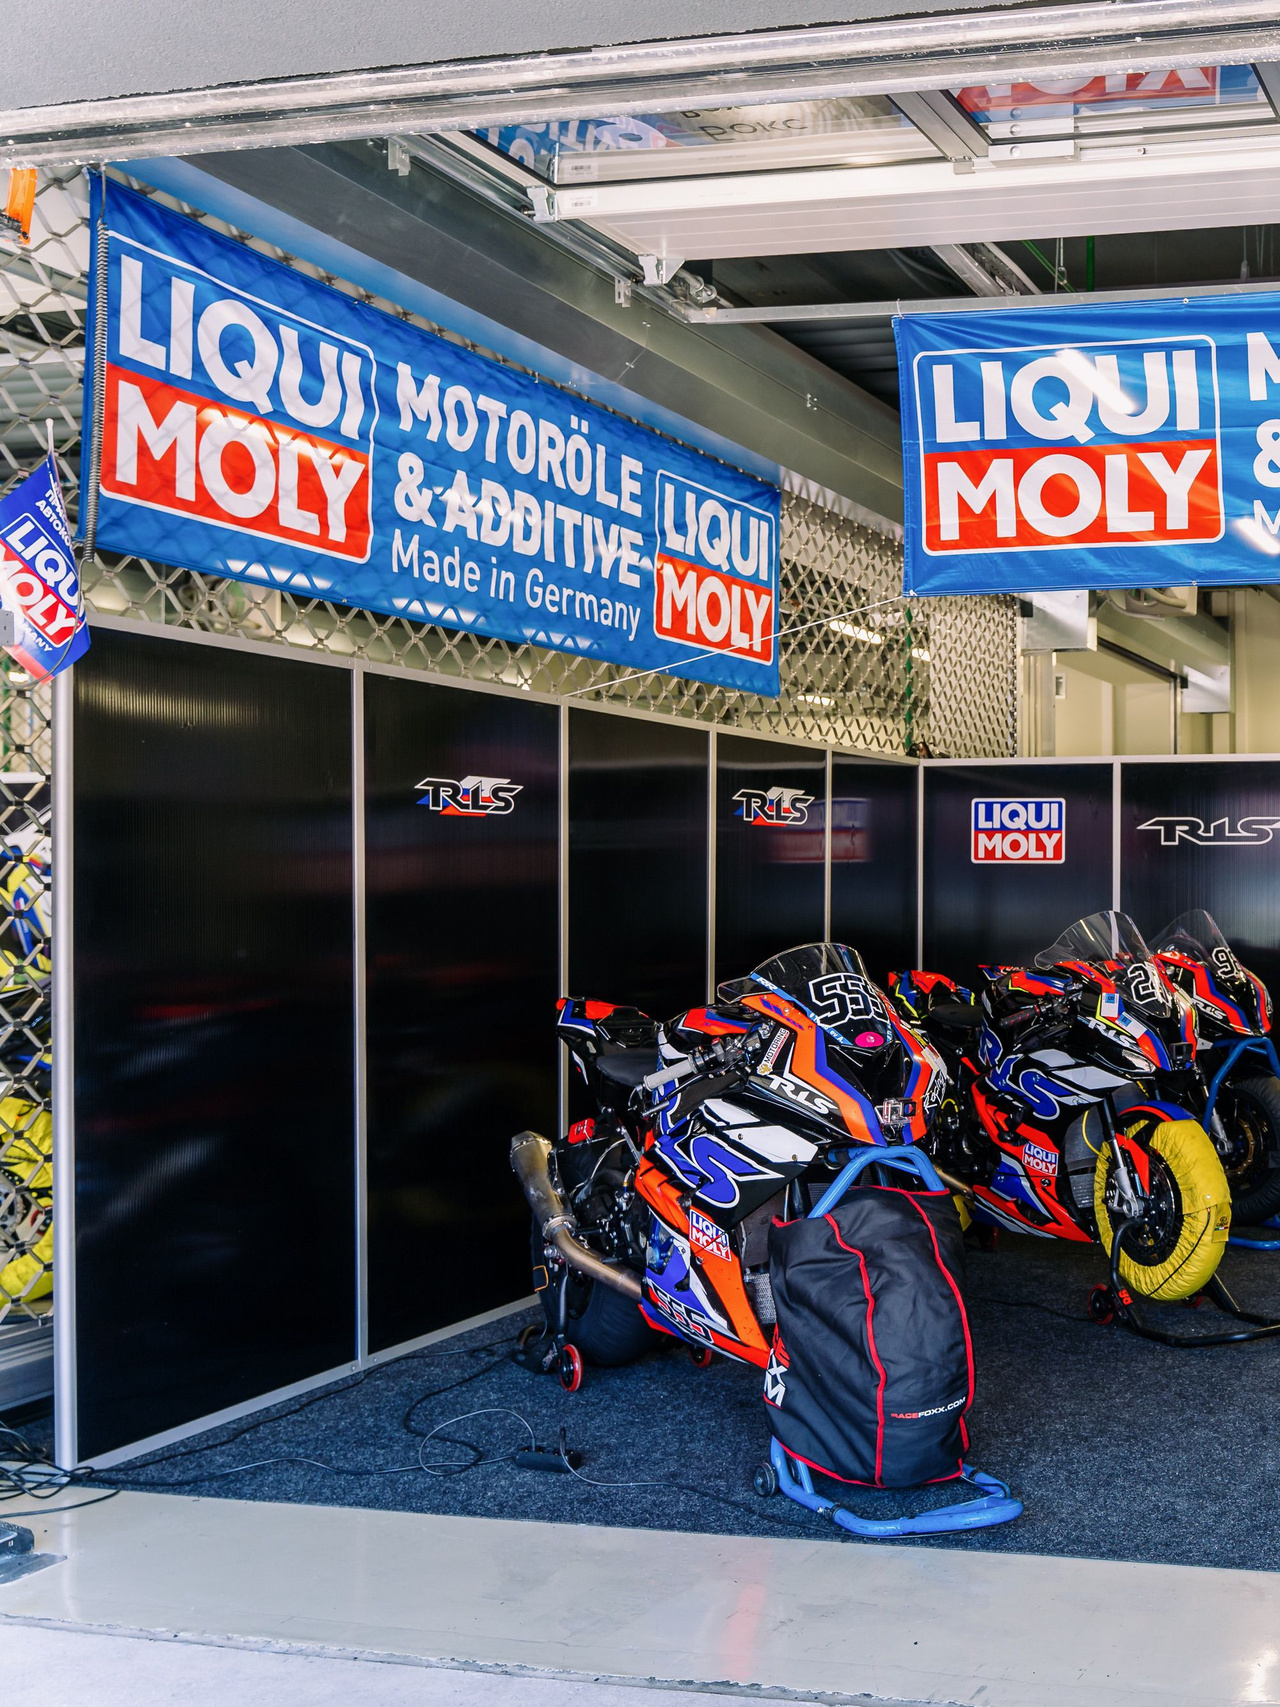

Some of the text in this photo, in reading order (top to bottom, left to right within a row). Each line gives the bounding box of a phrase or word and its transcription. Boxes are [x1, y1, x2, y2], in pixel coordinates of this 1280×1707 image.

[119, 251, 365, 441] LIQUI
[398, 361, 644, 518] MOTORÖLE
[932, 349, 1201, 444] LIQUI
[116, 380, 366, 543] MOLY
[938, 449, 1213, 543] MOLY
[396, 452, 644, 588] & ADDITIVE
[662, 481, 770, 580] LIQUI
[392, 530, 642, 641] Made in Germany
[659, 569, 771, 662] MOLY
[977, 832, 1061, 860] MOLY
[978, 803, 1060, 831] LIQUI
[764, 1028, 787, 1064] MOTORING
[1024, 1153, 1057, 1175] MOLY
[1025, 1143, 1056, 1163] LIQUI
[692, 1212, 729, 1247] LIQUI
[692, 1227, 730, 1260] MOLY
